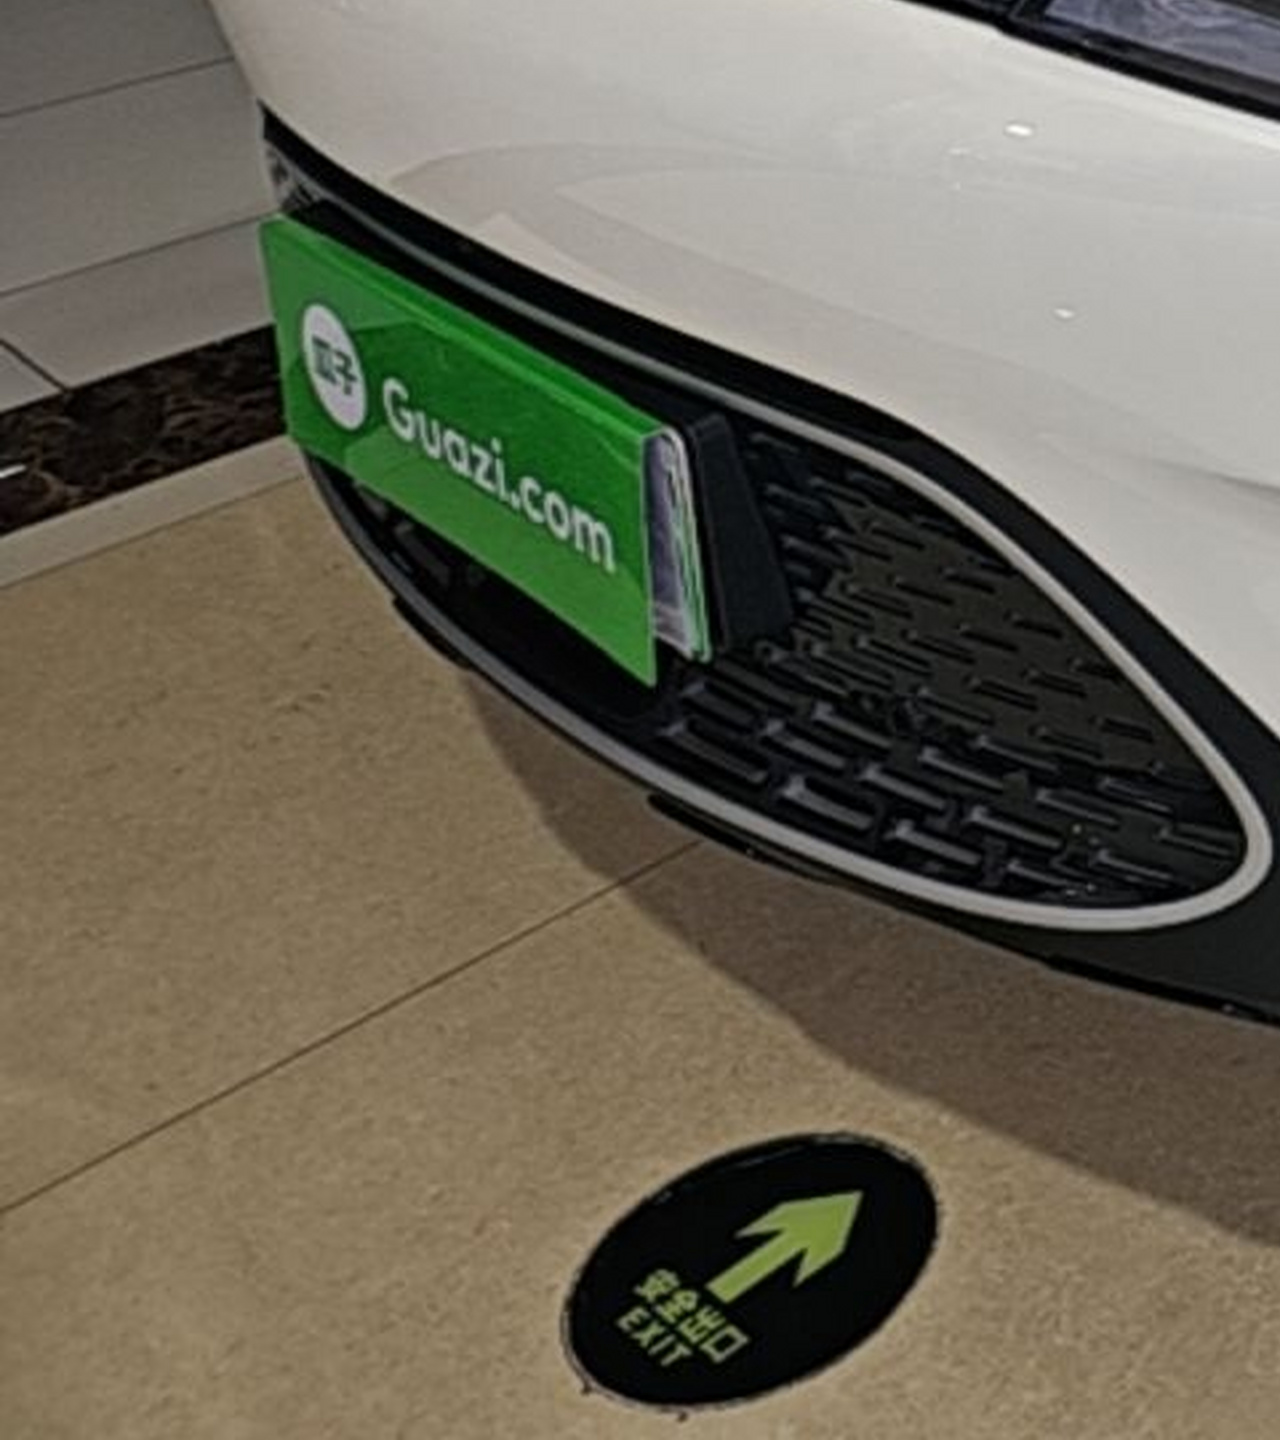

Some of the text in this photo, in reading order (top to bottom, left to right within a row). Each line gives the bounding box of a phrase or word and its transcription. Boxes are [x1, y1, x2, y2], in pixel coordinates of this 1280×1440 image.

[382, 376, 617, 574] Guazi.com
[616, 1306, 693, 1365] EXIT
[634, 1268, 749, 1363] 安全出口
